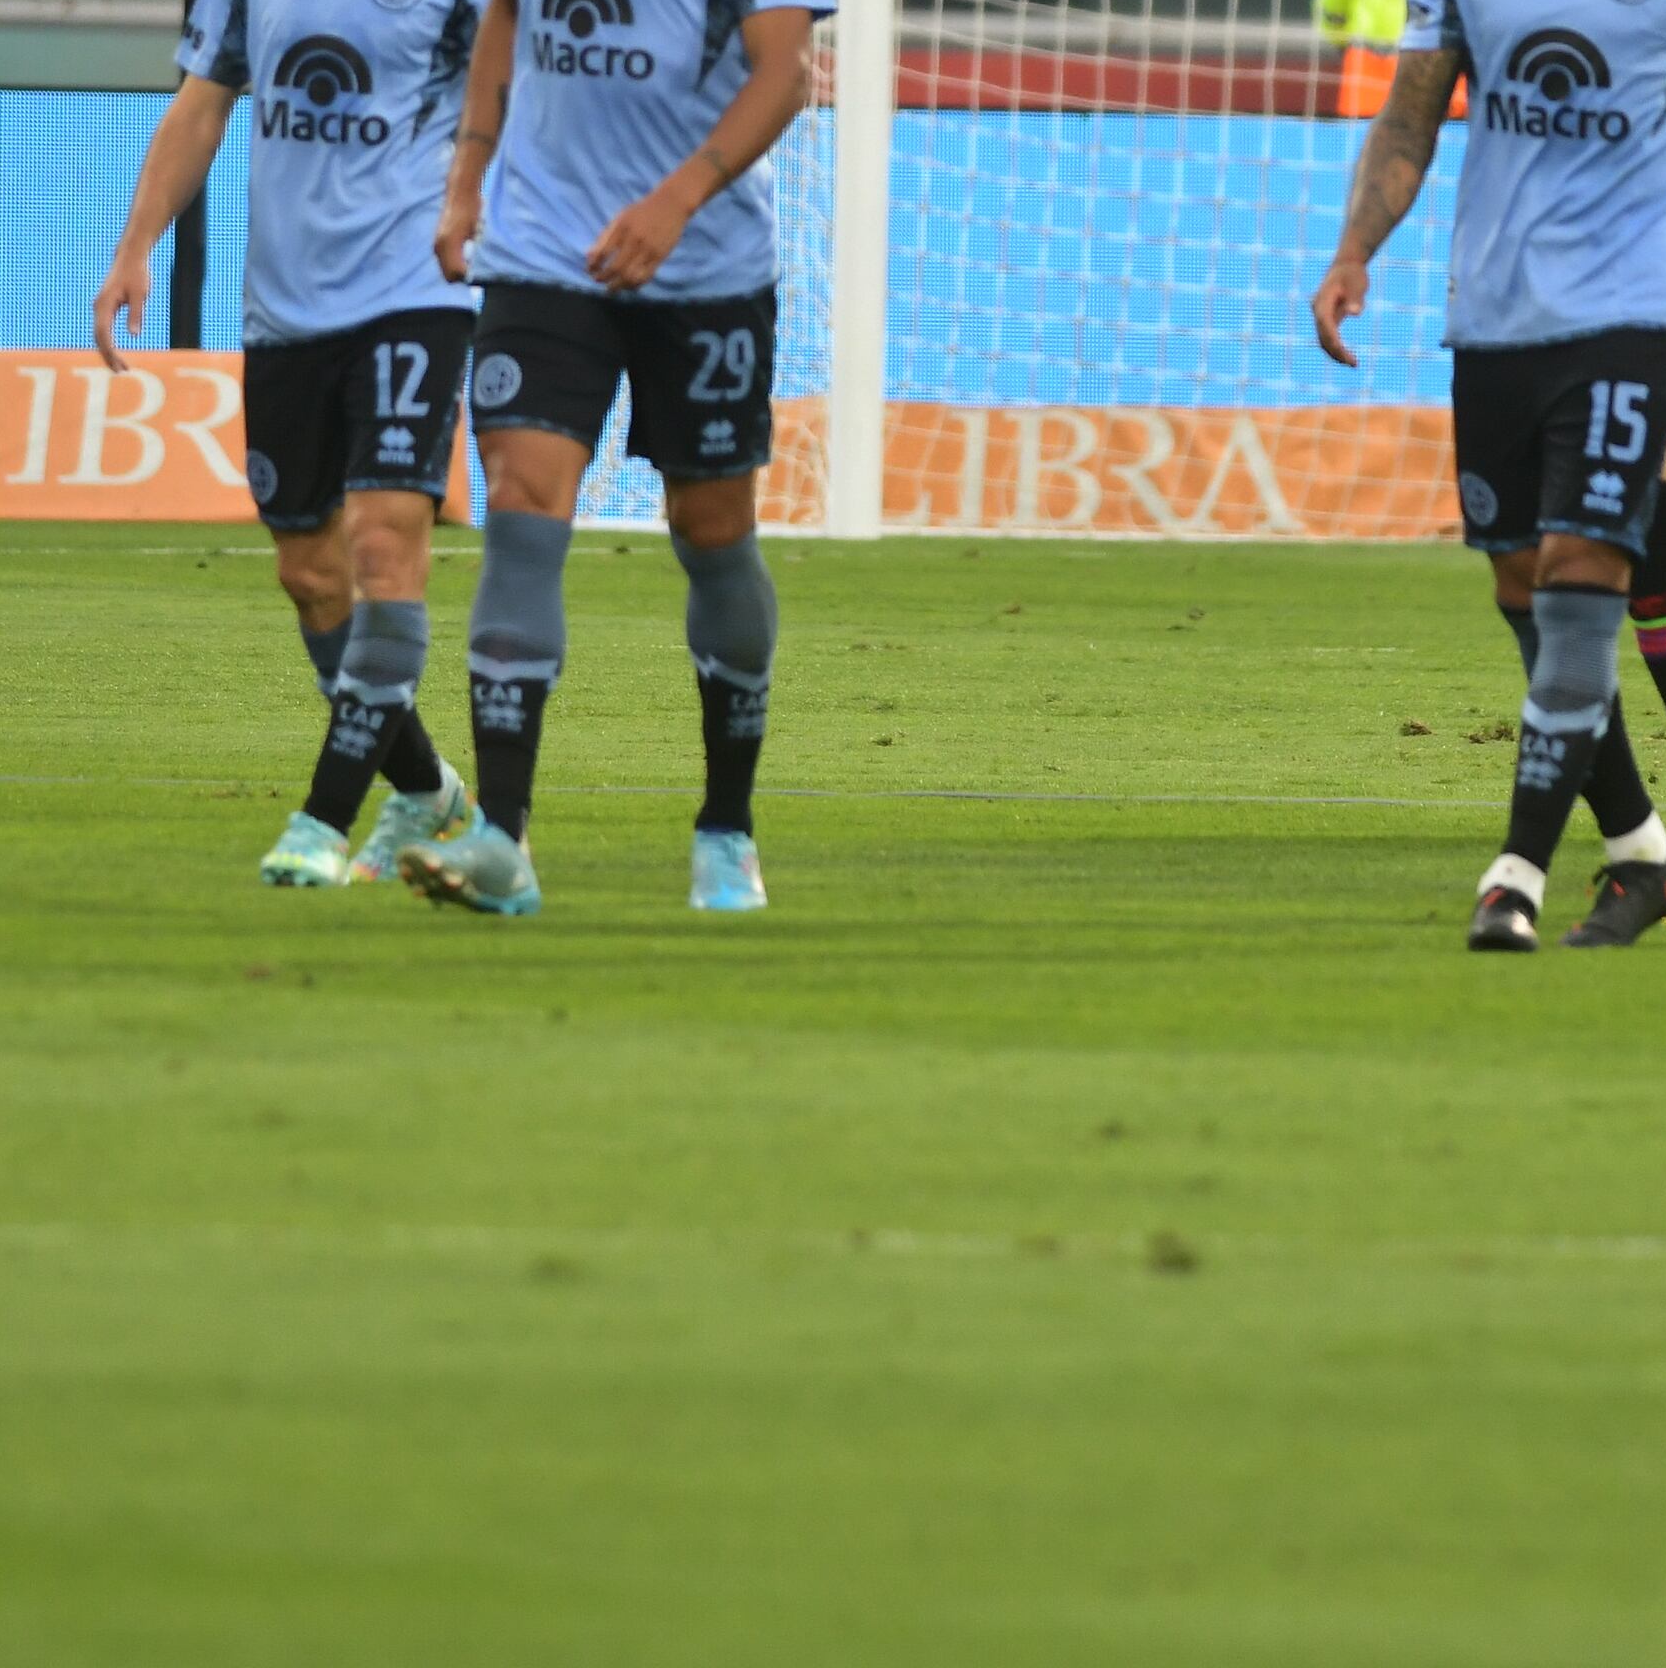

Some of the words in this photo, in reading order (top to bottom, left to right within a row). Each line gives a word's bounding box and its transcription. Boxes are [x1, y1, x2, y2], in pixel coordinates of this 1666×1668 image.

[537, 34, 656, 81] Macro
[259, 98, 392, 147] Macro
[1486, 90, 1632, 144] Macro
[373, 341, 431, 419] 12
[686, 328, 757, 403] 29
[1584, 380, 1650, 464] 15
